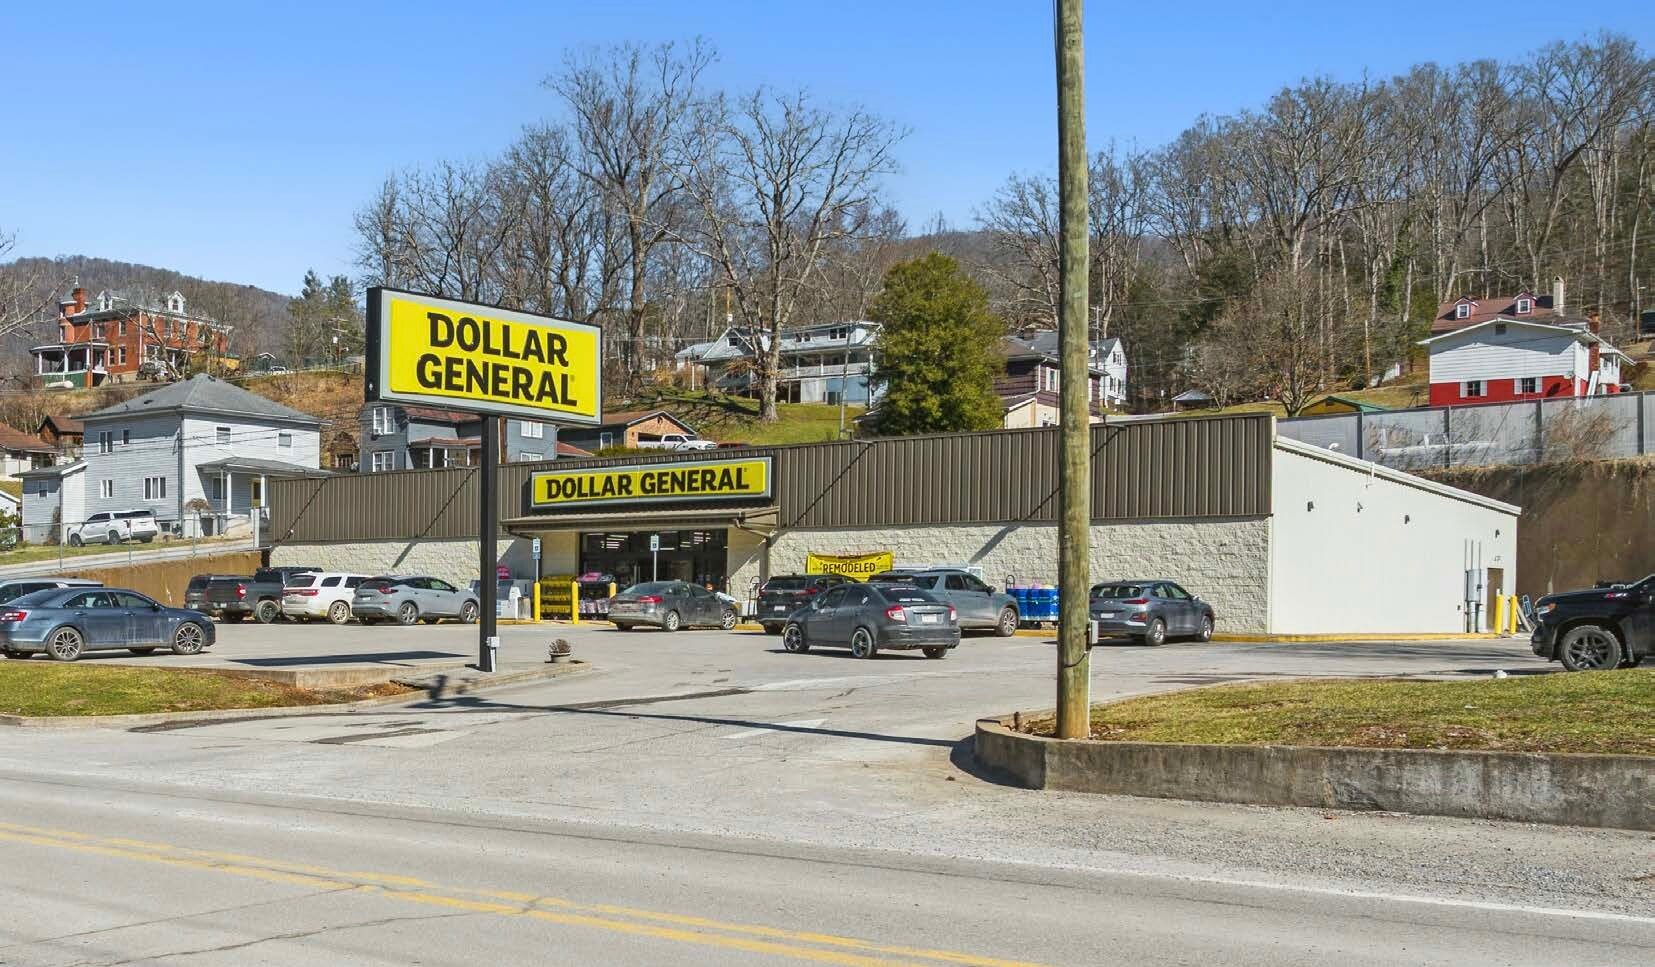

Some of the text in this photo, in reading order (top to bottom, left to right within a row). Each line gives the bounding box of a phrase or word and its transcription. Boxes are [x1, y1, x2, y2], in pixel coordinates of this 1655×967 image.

[427, 312, 569, 367] DOLLAR
[416, 353, 578, 407] GENERAL
[546, 467, 750, 499] DOLLAR GENERAL
[823, 562, 876, 573] REMODELED
